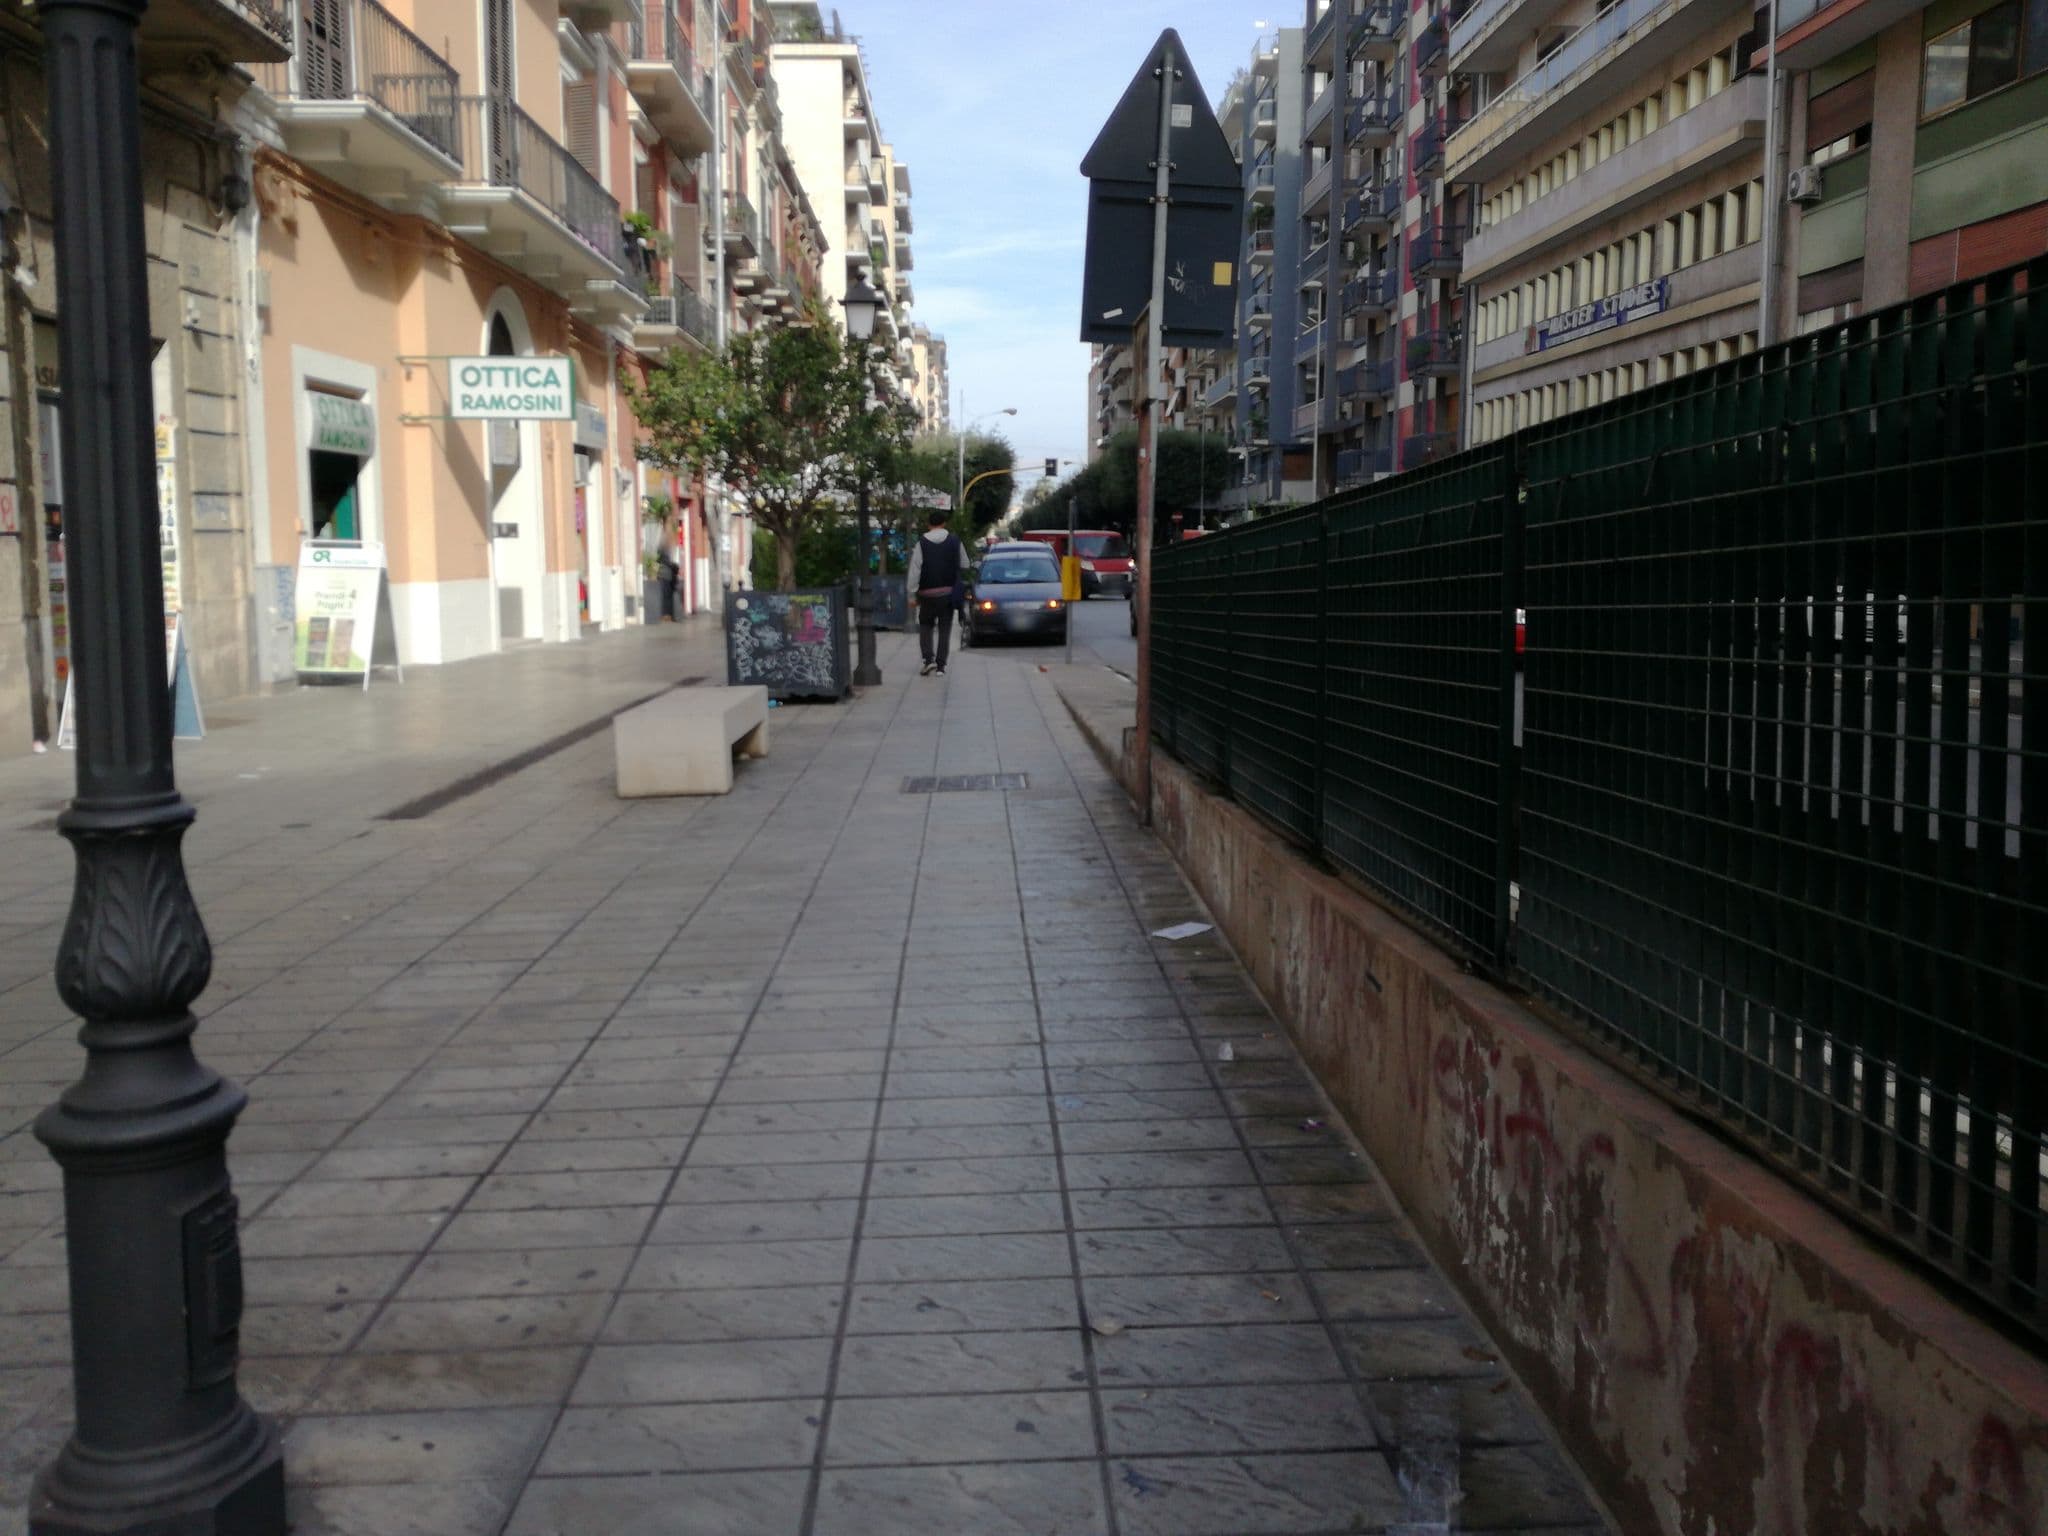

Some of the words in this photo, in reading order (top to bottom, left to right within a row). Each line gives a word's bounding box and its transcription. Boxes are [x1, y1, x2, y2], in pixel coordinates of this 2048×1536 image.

[1548, 306, 1595, 335] MASTER
[1600, 279, 1661, 317] STUDIES
[460, 365, 561, 388] OTTICA
[317, 396, 369, 428] OTTICA
[461, 394, 562, 411] RAMOSINI
[319, 425, 369, 450] RAMOSINI
